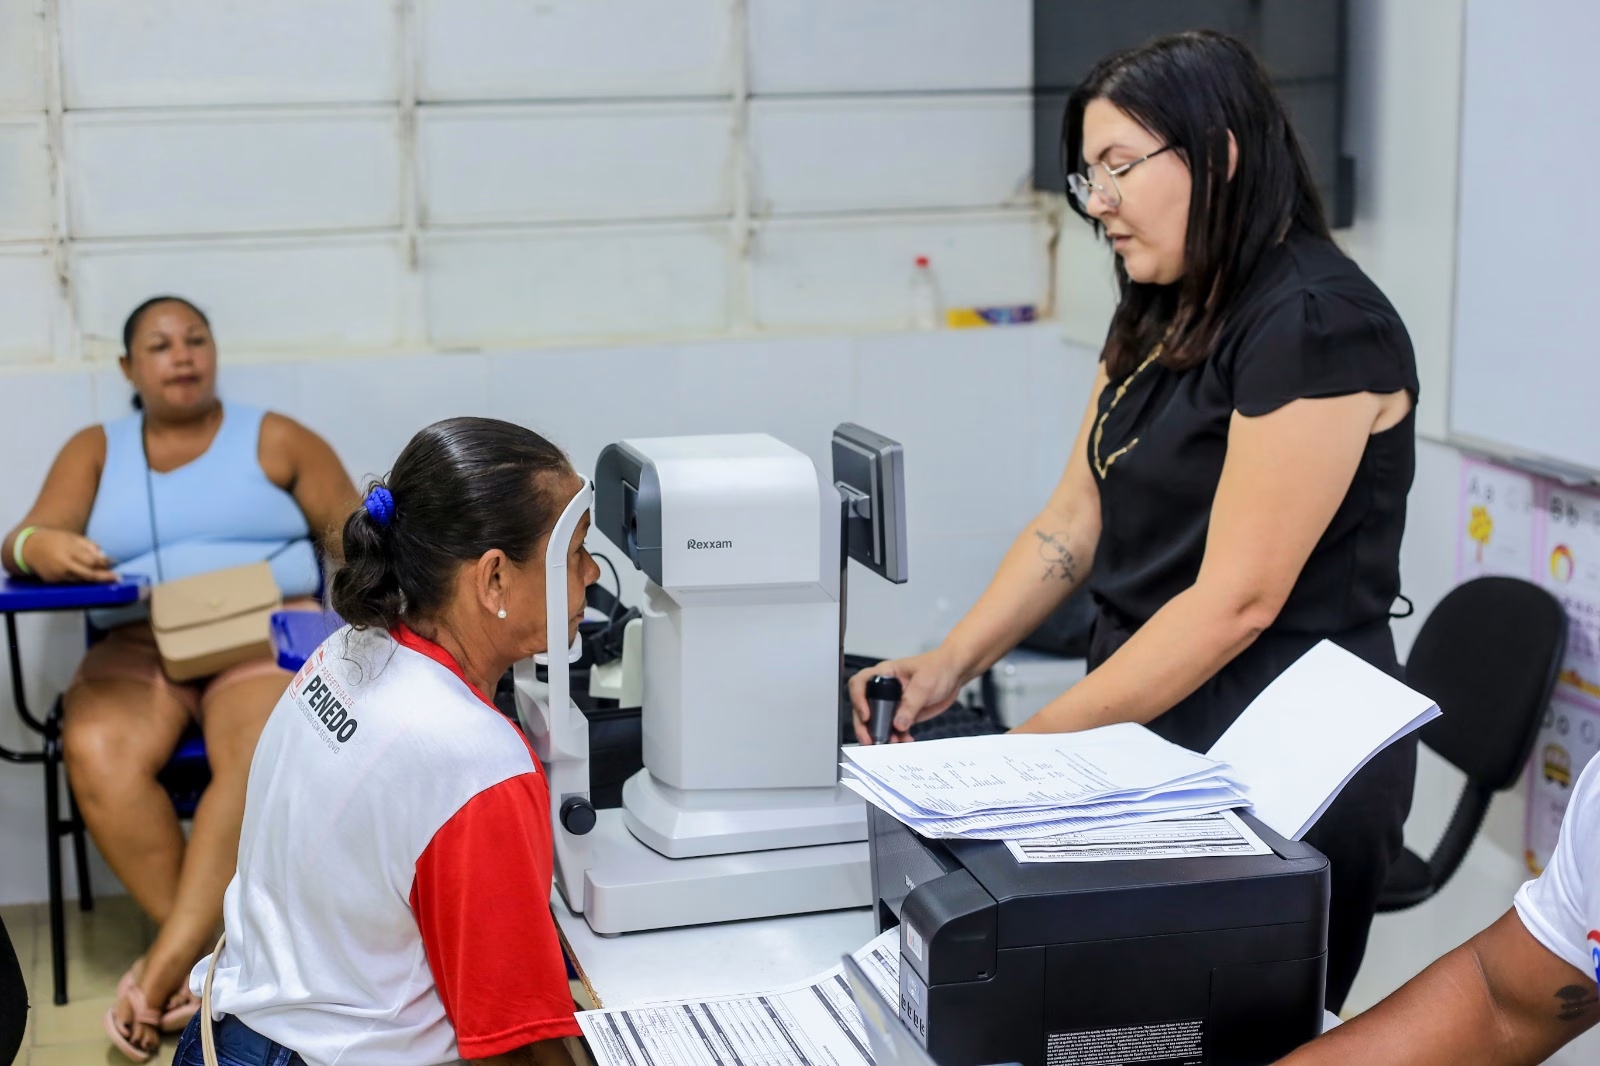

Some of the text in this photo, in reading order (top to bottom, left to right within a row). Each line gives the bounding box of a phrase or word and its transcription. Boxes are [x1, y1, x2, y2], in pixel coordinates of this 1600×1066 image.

[687, 538, 732, 550] Rexxam
[320, 666, 355, 708] PREFEITURA DE
[302, 674, 358, 743] PENEDO
[318, 729, 328, 741] SEU
[325, 738, 340, 754] POVO
